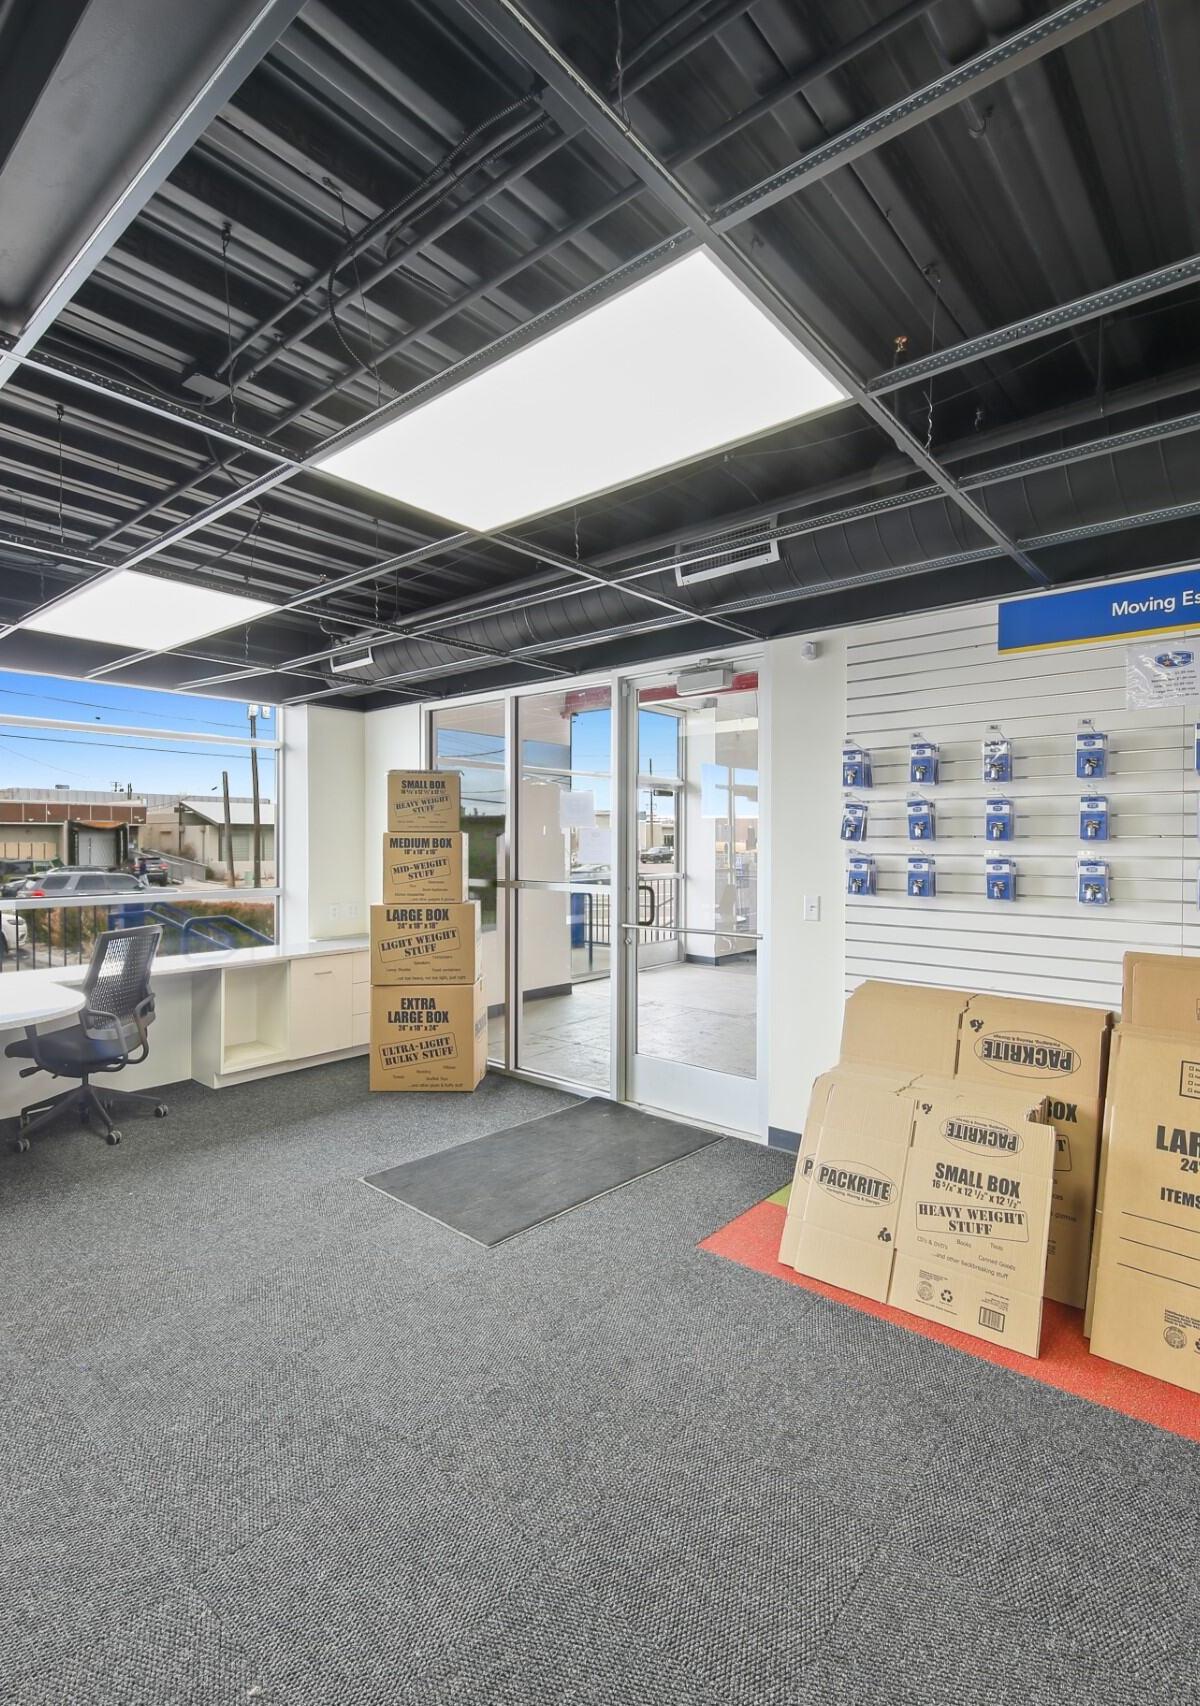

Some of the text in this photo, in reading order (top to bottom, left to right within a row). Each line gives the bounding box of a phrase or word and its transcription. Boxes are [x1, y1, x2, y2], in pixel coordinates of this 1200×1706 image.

[1112, 590, 1200, 617] Moving Es
[401, 780, 446, 789] SMALL BOX
[395, 796, 449, 810] HEAVY WEIGHT
[412, 805, 434, 813] STUFF
[389, 838, 452, 848] MEDIUM BOX
[392, 859, 448, 874] MID-WEIGHT
[408, 870, 435, 880] STUFF
[386, 909, 449, 921] LARGE BOX
[381, 929, 457, 952] LIGHT WEIGHT
[404, 943, 437, 957] STUFF
[400, 998, 436, 1010] EXTRA
[387, 1011, 449, 1023] LARGE BOX
[382, 1036, 450, 1057] ULTRA-LIGHT
[385, 1046, 454, 1065] BULKY STUFF
[983, 1040, 1073, 1071] PACKRITE
[947, 1122, 1017, 1151] PACKRITE
[1156, 1125, 1200, 1158] LAR
[819, 1166, 891, 1201] PACKRITE
[935, 1162, 1021, 1199] SMALL BOX
[932, 1179, 941, 1189] 16
[964, 1188, 973, 1197] 12
[996, 1196, 1005, 1206] 12
[1160, 1186, 1200, 1209] ITEMS
[918, 1203, 1025, 1225] HEAVY WEIGHT
[948, 1220, 993, 1235] STUFF
[956, 1239, 972, 1248] Books
[996, 1271, 1009, 1280] stuff
